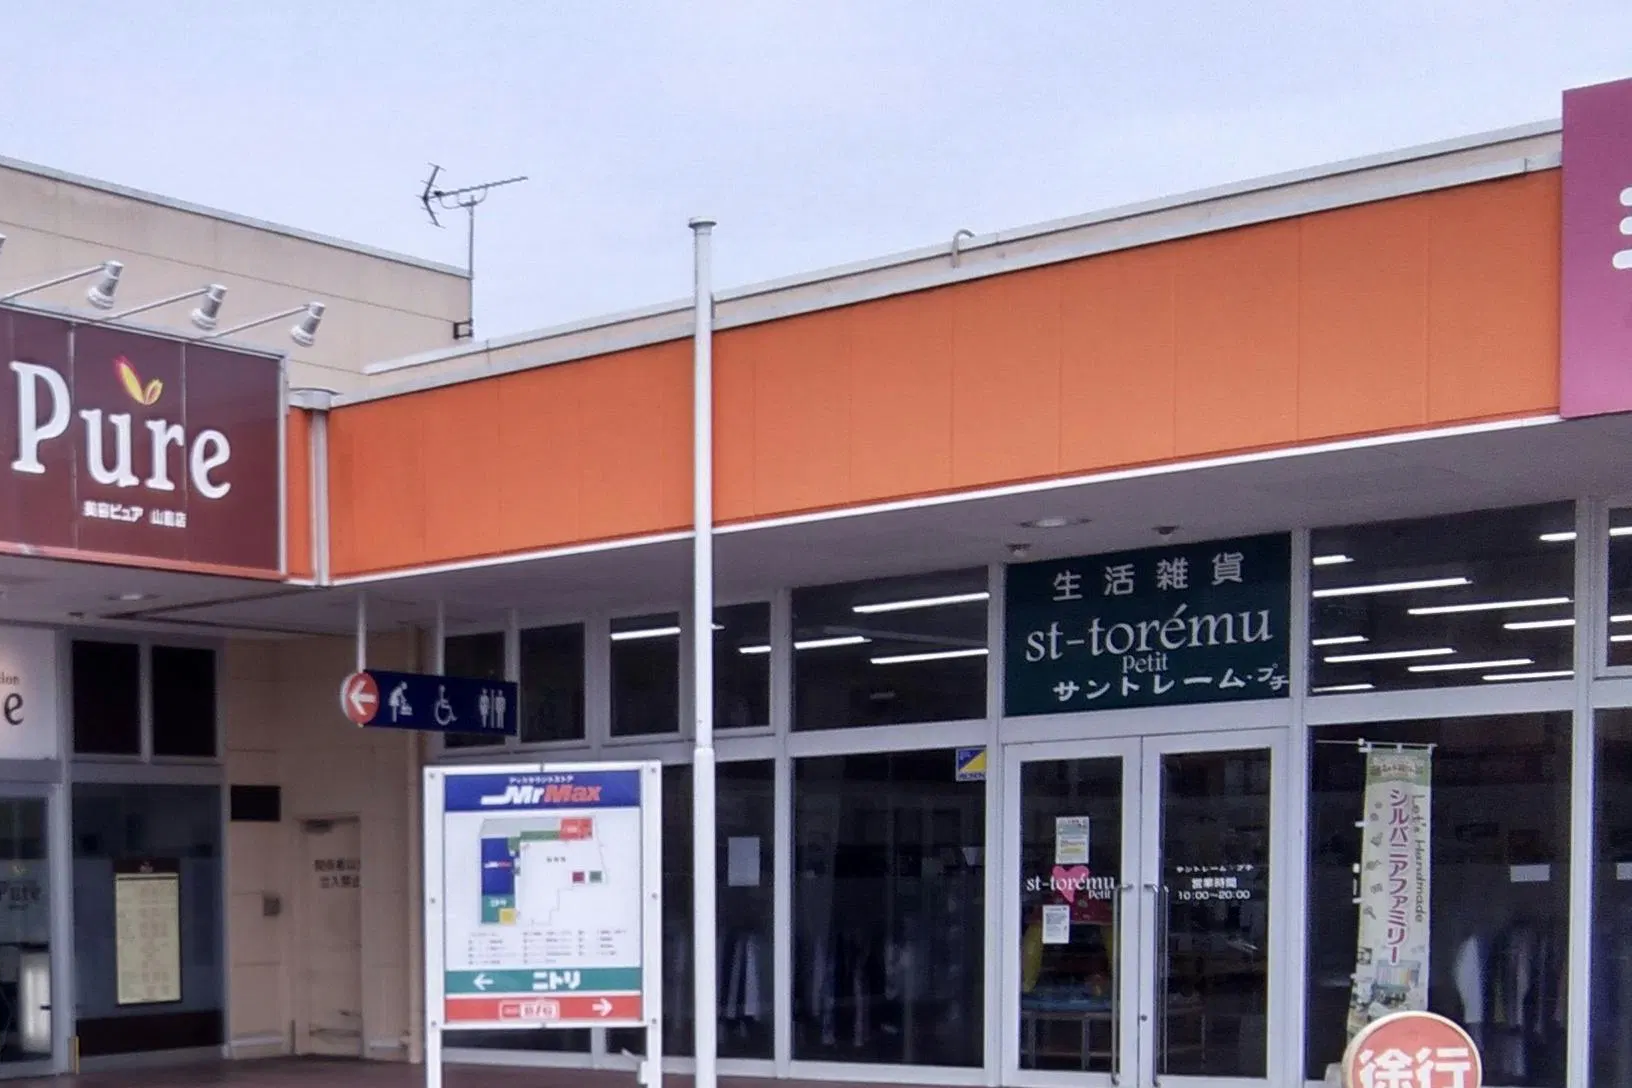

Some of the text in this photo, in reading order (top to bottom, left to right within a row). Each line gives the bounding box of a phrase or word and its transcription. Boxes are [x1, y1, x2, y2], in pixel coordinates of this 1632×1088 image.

[9, 361, 232, 498] Pure
[1052, 552, 1244, 601] 生活雑貨
[1025, 603, 1273, 662] st-torému
[480, 784, 602, 806] MrMax
[1026, 872, 1115, 892] st-torému
[1386, 788, 1409, 964] シルバニアファミリー
[532, 970, 581, 990] ニトリ
